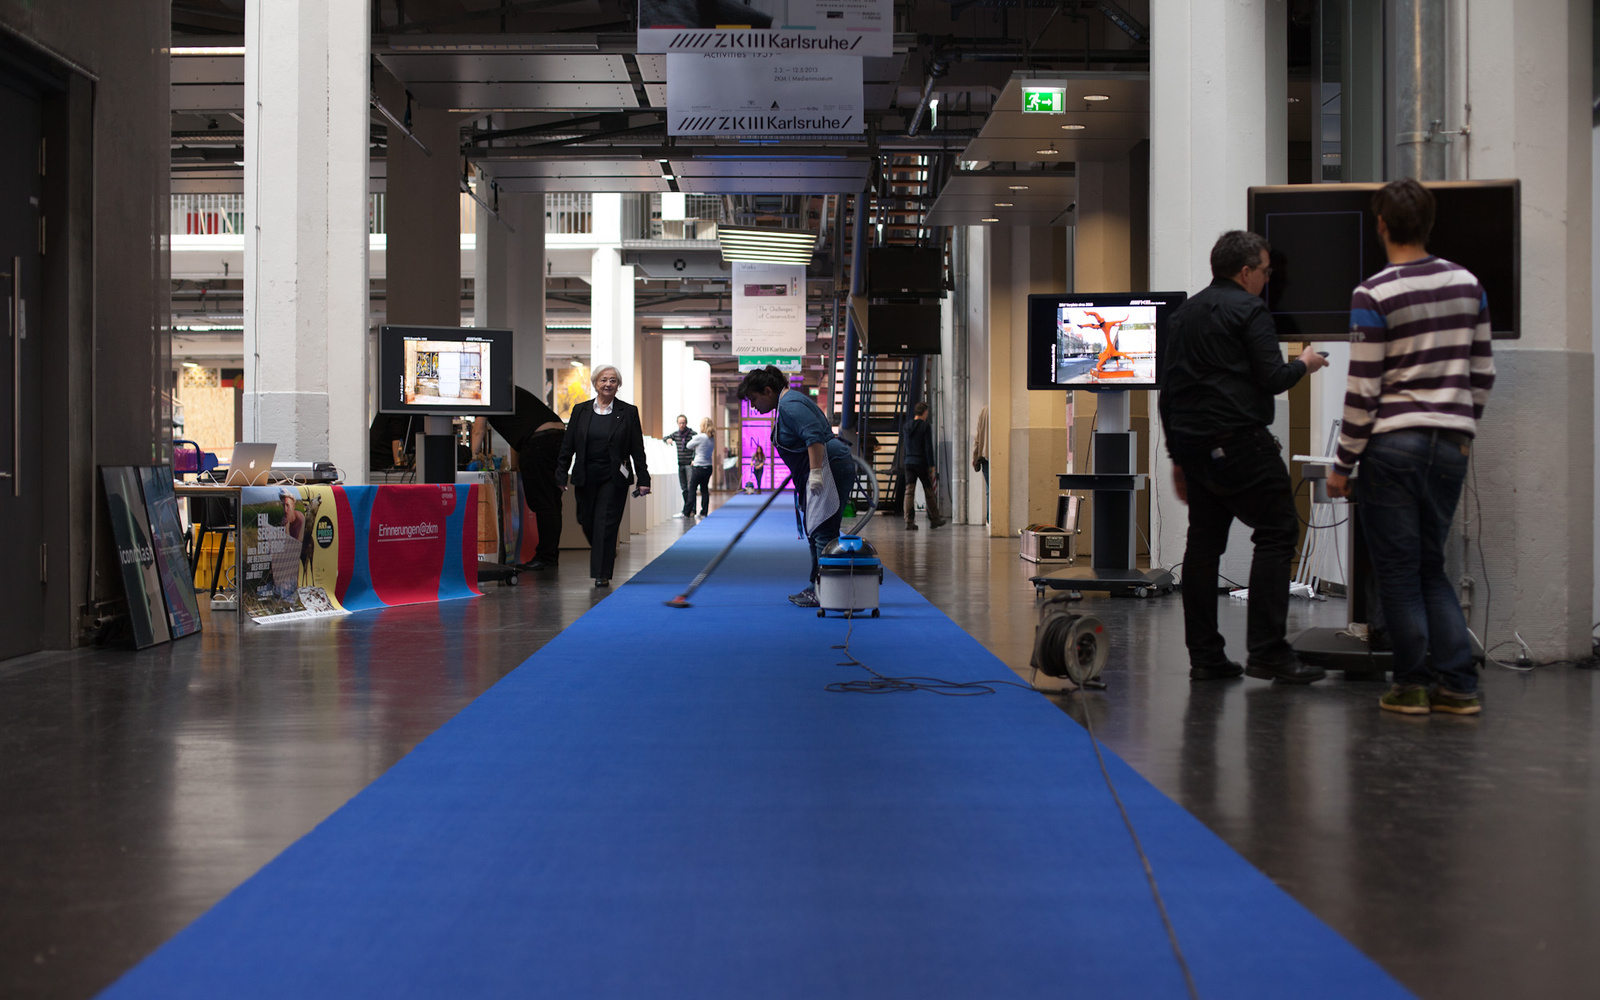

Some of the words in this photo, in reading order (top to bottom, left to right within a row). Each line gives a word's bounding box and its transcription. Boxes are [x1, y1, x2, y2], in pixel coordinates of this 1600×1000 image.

[257, 513, 269, 526] EIN
[318, 521, 328, 529] ART
[317, 528, 333, 537] PRESS
[378, 522, 438, 537] Erinnerungen@zkm
[257, 541, 270, 554] DER
